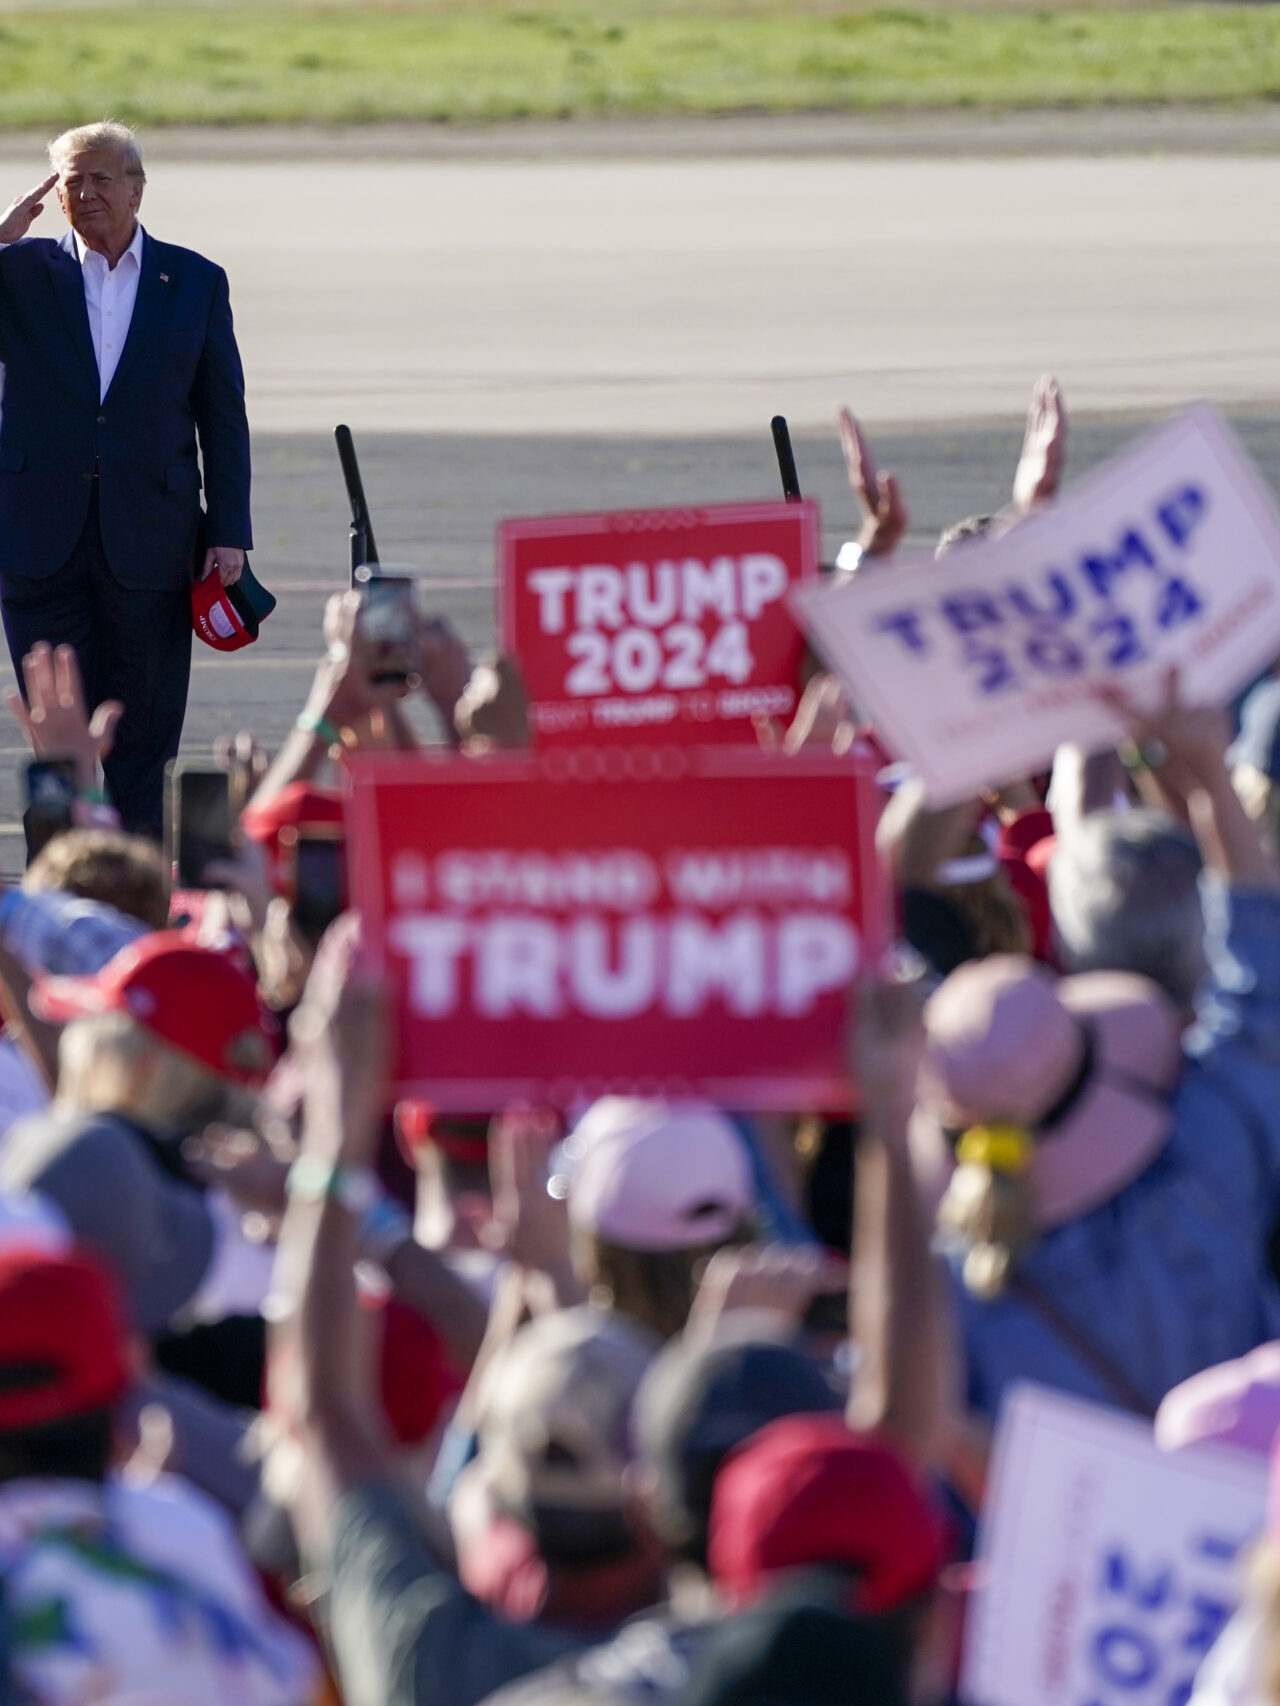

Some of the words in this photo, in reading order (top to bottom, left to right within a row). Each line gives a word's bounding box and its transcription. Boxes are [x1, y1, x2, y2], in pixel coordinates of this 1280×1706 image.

[527, 552, 788, 635] TRUMP
[871, 481, 1207, 657] TRUMP
[564, 616, 754, 696] 2024
[966, 574, 1206, 696] 2024
[436, 848, 655, 905] STAND
[664, 847, 851, 902] WITH
[388, 912, 862, 1021] TRUMP
